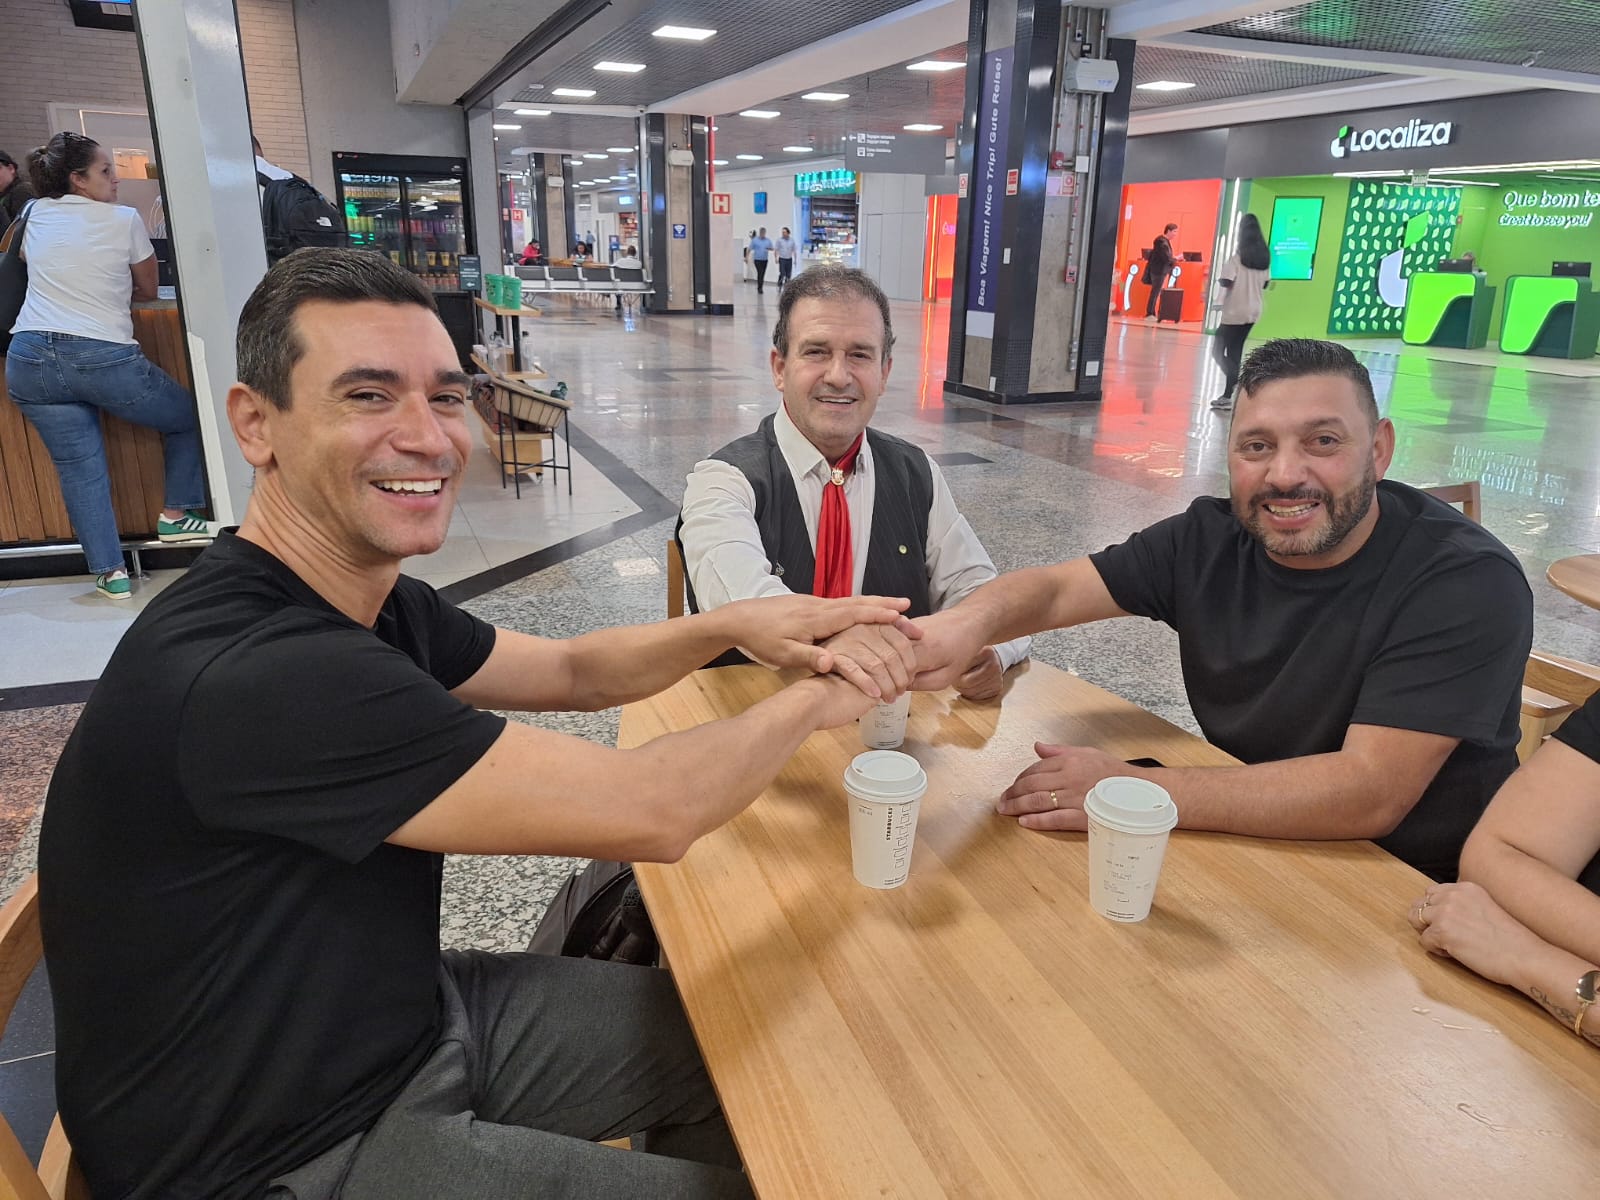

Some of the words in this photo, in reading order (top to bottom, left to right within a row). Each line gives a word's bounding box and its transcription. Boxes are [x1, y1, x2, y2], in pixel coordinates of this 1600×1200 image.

[992, 57, 1002, 104] Reise!
[989, 108, 999, 143] Gute
[1350, 118, 1452, 152] Localiza
[986, 147, 997, 179] Trip!
[714, 194, 730, 213] H
[984, 184, 993, 216] Nice
[1503, 190, 1538, 212] Que
[1540, 189, 1580, 208] bom
[1499, 213, 1531, 226] Great
[1531, 213, 1544, 226] to
[1563, 212, 1593, 230] you!
[980, 219, 991, 275] Viagem!
[977, 279, 987, 307] Boa
